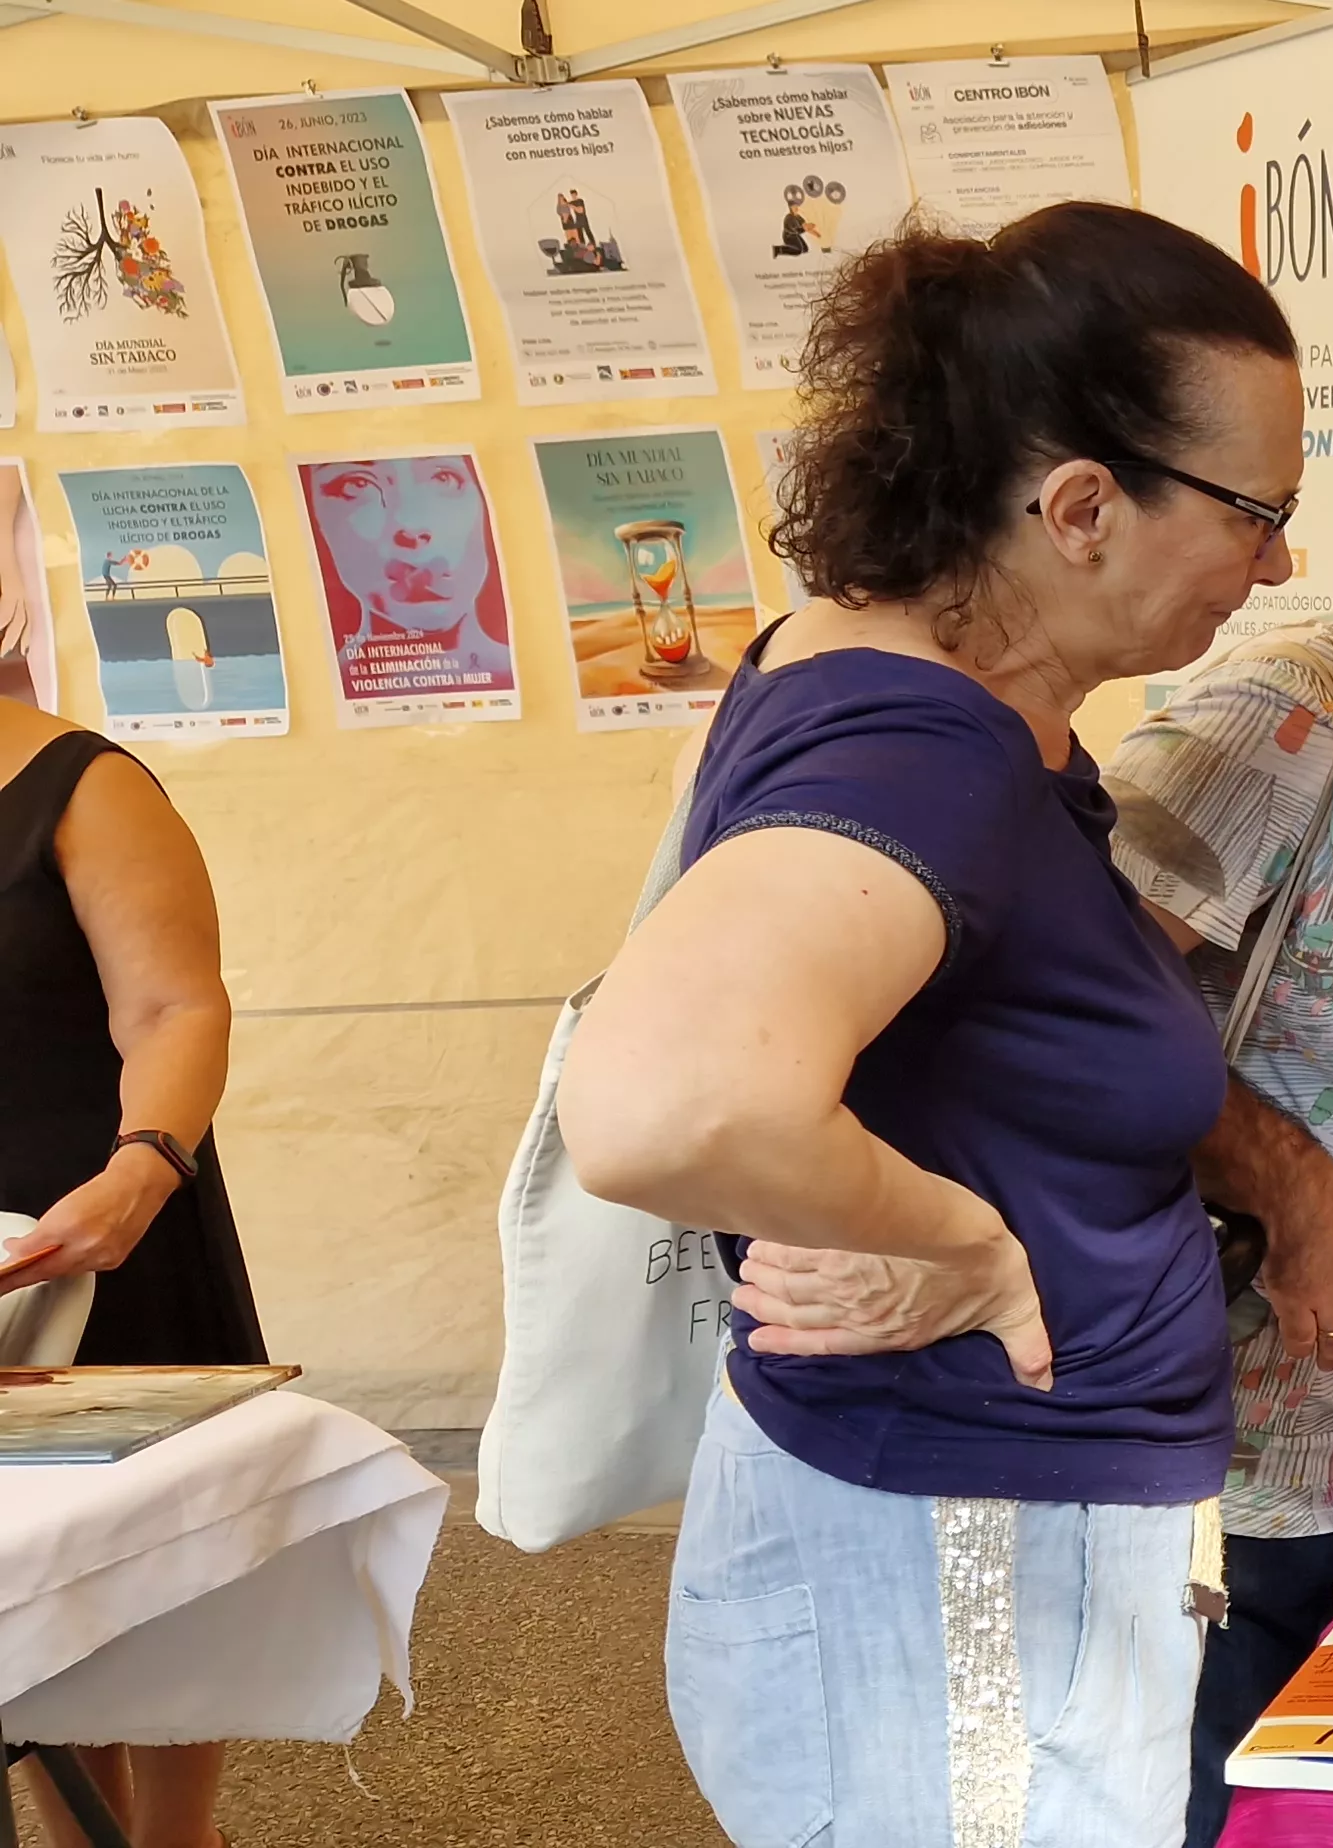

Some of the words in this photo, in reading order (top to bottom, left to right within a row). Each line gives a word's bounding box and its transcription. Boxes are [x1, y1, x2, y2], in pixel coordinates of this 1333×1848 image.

[712, 94, 773, 111] ¿Sabemos
[776, 92, 809, 104] cómo
[811, 89, 848, 101] hablar
[954, 87, 1012, 102] CENTRO
[1015, 83, 1050, 98] IBÓN
[340, 112, 367, 124] 2023
[485, 114, 541, 130] ¿Sabemos
[544, 111, 575, 124] cómo
[578, 108, 614, 121] hablar
[737, 113, 771, 124] sobre
[774, 104, 833, 122] NUEVAS
[943, 113, 991, 124] Asociación
[993, 112, 1014, 123] para
[1016, 111, 1024, 120] la
[1026, 109, 1065, 119] atención
[1067, 111, 1073, 121] y
[508, 132, 539, 143] sobre
[542, 124, 599, 141] DROGAS
[740, 122, 844, 144] TECNOLOGÍAS
[952, 123, 1002, 134] prevención
[1004, 122, 1016, 131] de
[1018, 121, 1067, 131] adicciones
[253, 145, 279, 162] DÍA
[287, 136, 403, 159] INTERNACIONAL
[506, 149, 527, 161] con
[529, 144, 579, 160] nuestros
[581, 142, 614, 156] hijos?
[739, 148, 761, 159] con
[764, 144, 816, 156] nuestros
[819, 140, 853, 155] hijos?
[276, 163, 336, 178] CONTRA
[340, 160, 356, 172] EL
[359, 157, 390, 171] USO
[286, 179, 355, 196] INDEBIDO
[359, 178, 368, 190] Y
[374, 176, 388, 189] EL
[285, 199, 343, 216] TRÁFICO
[349, 193, 397, 210] ILÍCITO
[302, 220, 321, 233] DE
[326, 214, 388, 231] DROGAS
[95, 339, 114, 350] DÍA
[117, 338, 166, 348] MUNDIAL
[90, 352, 114, 364] SIN
[117, 350, 176, 363] TABACO
[586, 452, 615, 467] DÍA
[618, 447, 684, 464] MUNDIAL
[597, 472, 620, 487] SIN
[627, 468, 684, 484] TABACO
[92, 490, 111, 502] DÍA
[113, 487, 198, 500] INTERNACIONAL
[201, 486, 215, 496] DE
[217, 486, 229, 495] LA
[103, 506, 137, 516] LUCHA
[140, 502, 188, 513] CONTRA
[190, 502, 200, 511] EL
[203, 501, 225, 510] USO
[108, 518, 158, 530] INDEBIDO
[161, 518, 167, 527] Y
[171, 517, 182, 526] EL
[185, 514, 227, 526] TRÁFICO
[157, 532, 170, 542] DE
[173, 529, 221, 541] DROGAS
[1263, 592, 1331, 611] PATOLÓGICO
[346, 643, 365, 660] DÍA
[368, 642, 445, 658] INTERNACIONAL
[349, 666, 358, 676] de
[360, 665, 368, 675] la
[370, 657, 440, 674] ELIMINACIÓN
[352, 675, 411, 692] VIOLENCIA
[413, 673, 454, 688] CONTRA
[463, 672, 492, 684] MUJER
